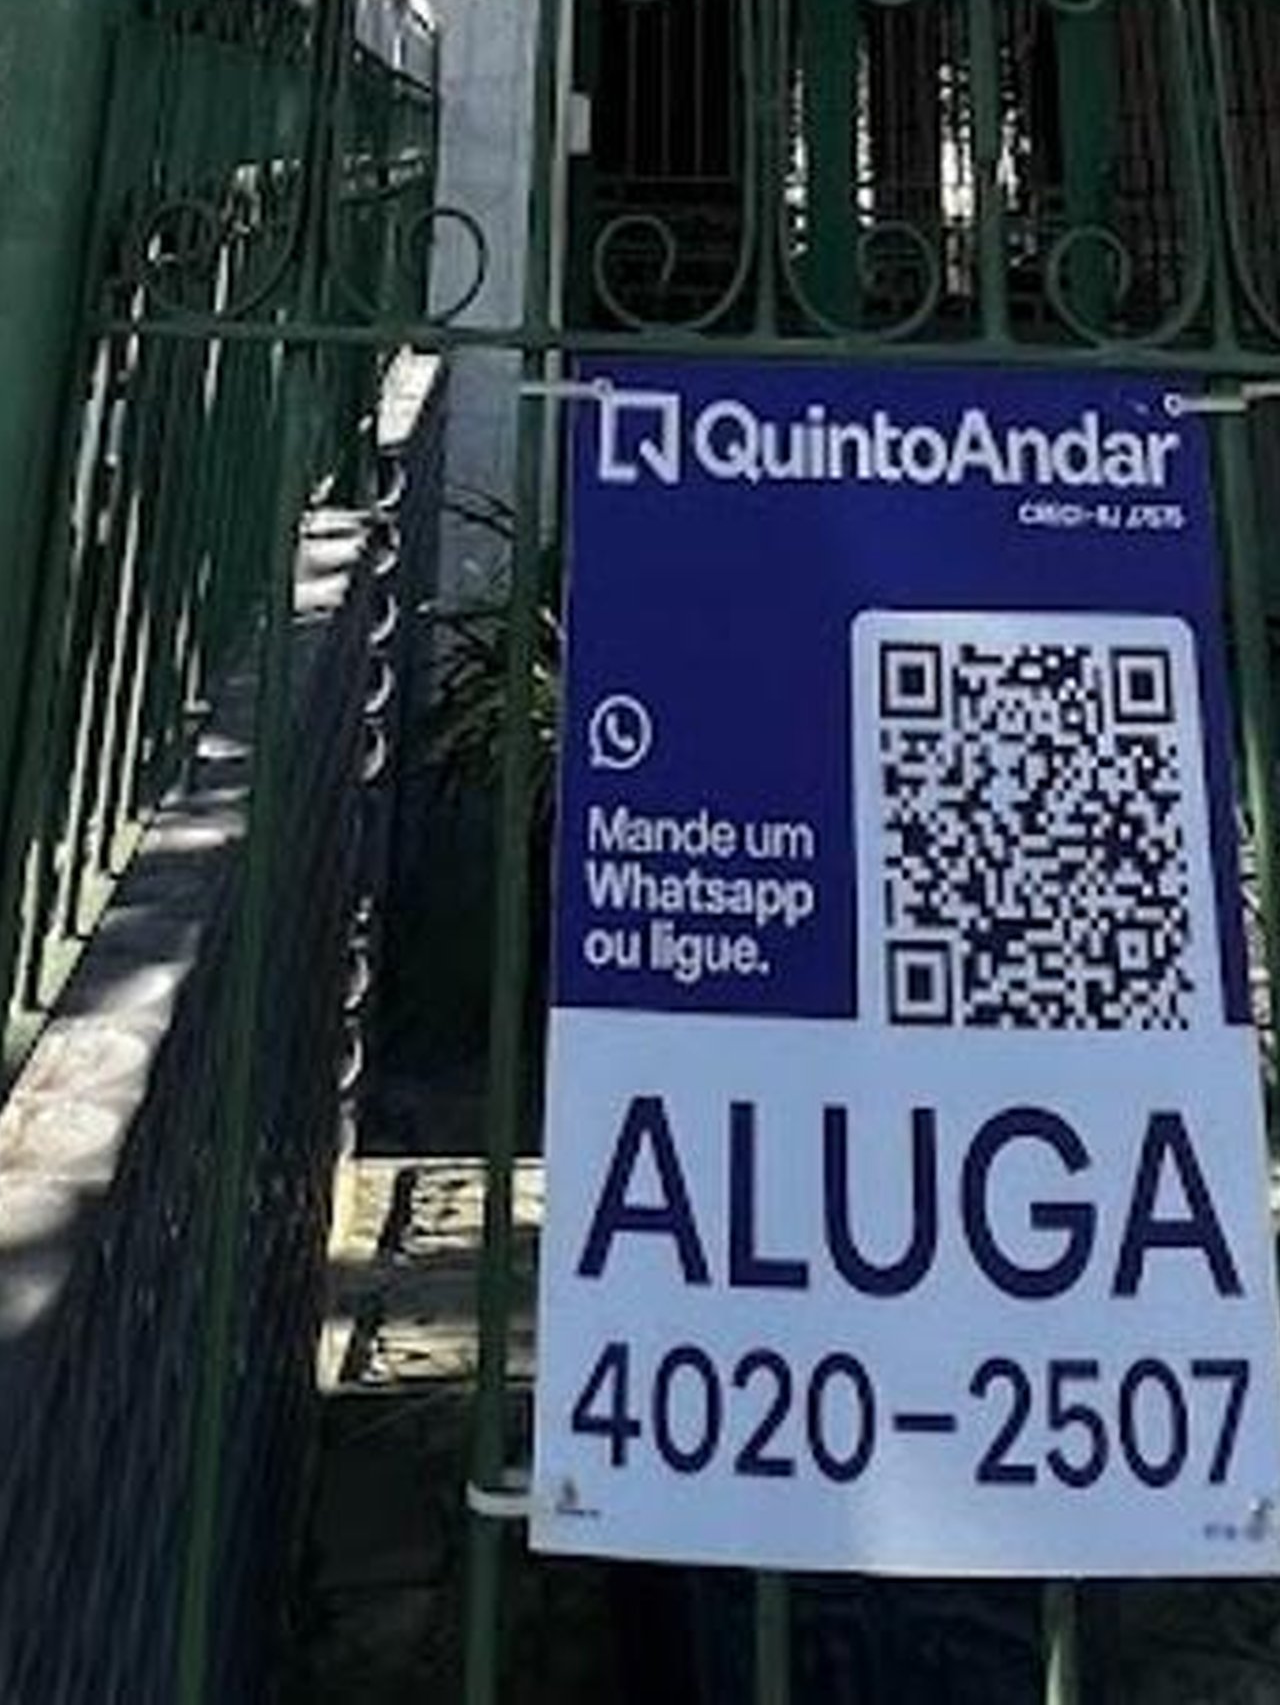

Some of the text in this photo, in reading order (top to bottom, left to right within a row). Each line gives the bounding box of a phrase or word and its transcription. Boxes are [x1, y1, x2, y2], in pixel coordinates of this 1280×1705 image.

[694, 399, 1180, 486] QuintoAndar
[588, 805, 814, 859] Mande um
[585, 860, 815, 928] Whatsapp
[583, 918, 770, 984] ou ligue.
[575, 1095, 1245, 1299] ALUGA
[571, 1342, 1252, 1489] 4020-2507
